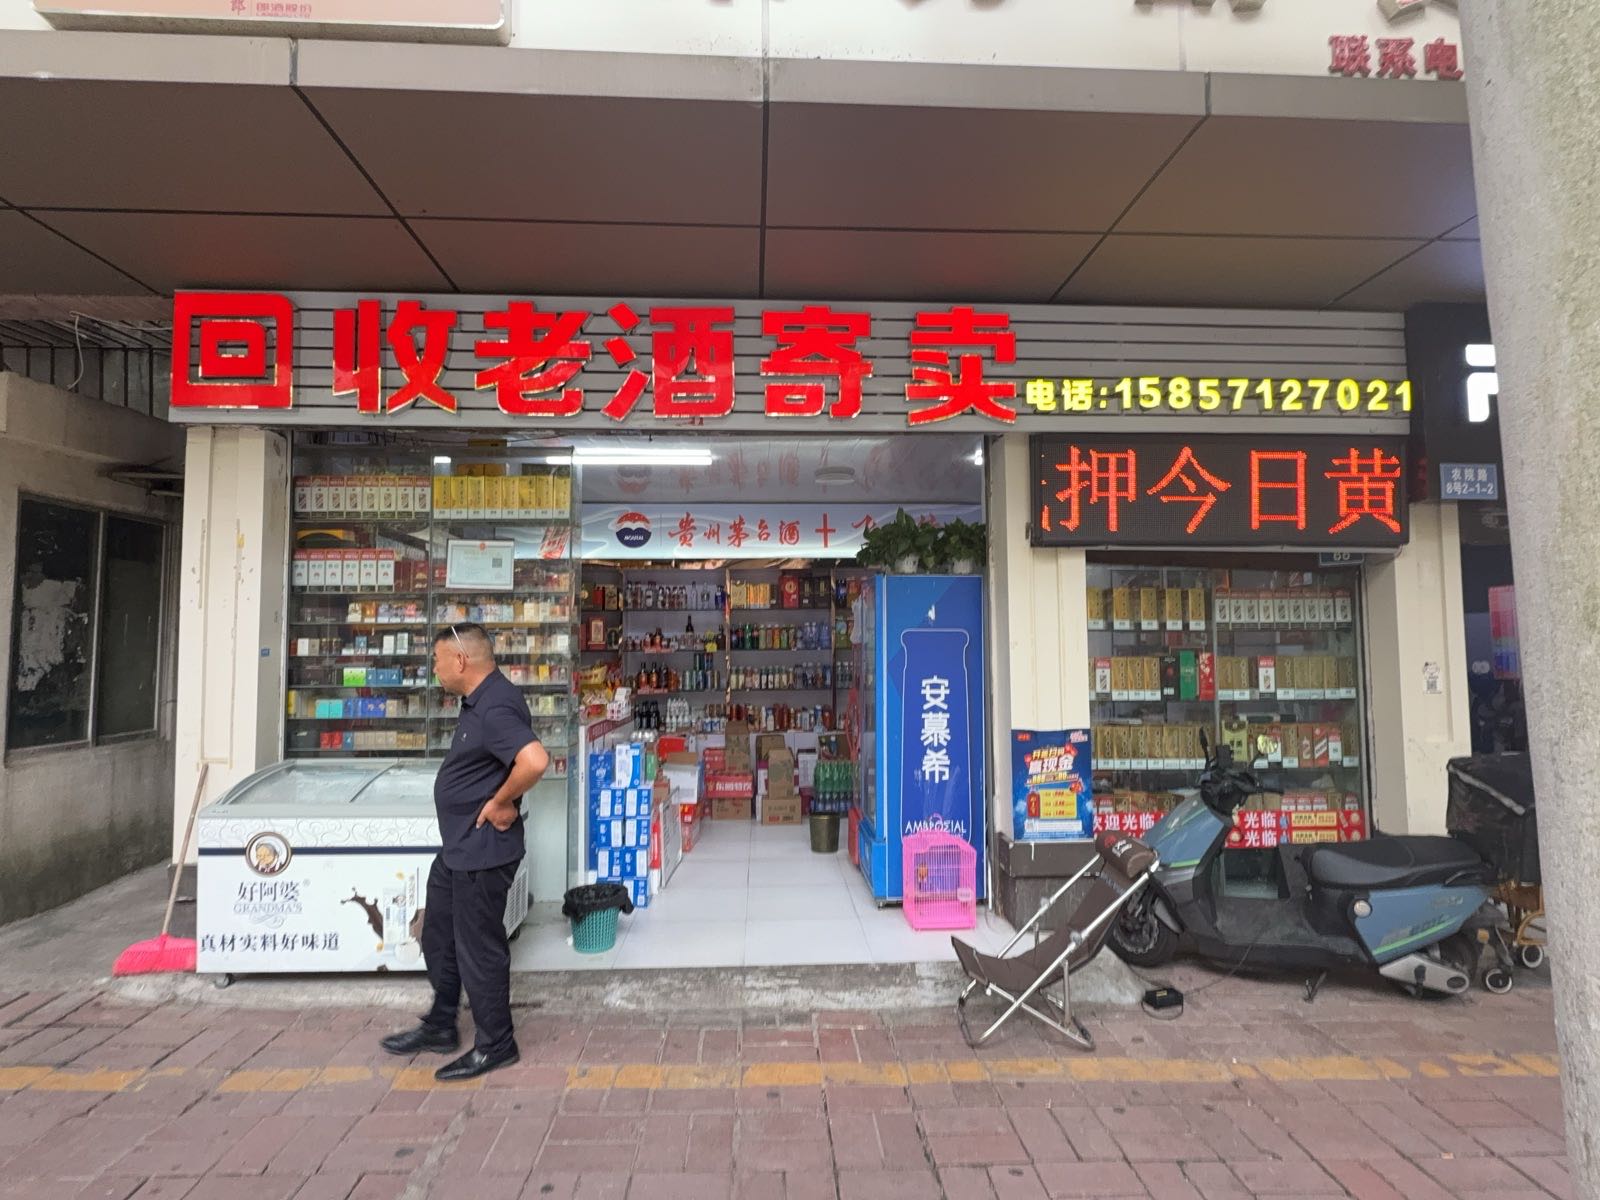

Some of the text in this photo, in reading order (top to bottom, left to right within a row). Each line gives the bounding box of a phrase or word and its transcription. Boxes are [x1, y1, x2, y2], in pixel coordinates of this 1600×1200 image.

[169, 291, 1017, 425] 回收老酒寄卖
[1042, 446, 1401, 533] 押今日黄
[920, 675, 951, 783] 安慕希
[1244, 811, 1277, 829] 光临
[1244, 829, 1278, 847] 光临
[238, 881, 301, 902] 好阿婆
[200, 933, 340, 952] 真材实料好味道
